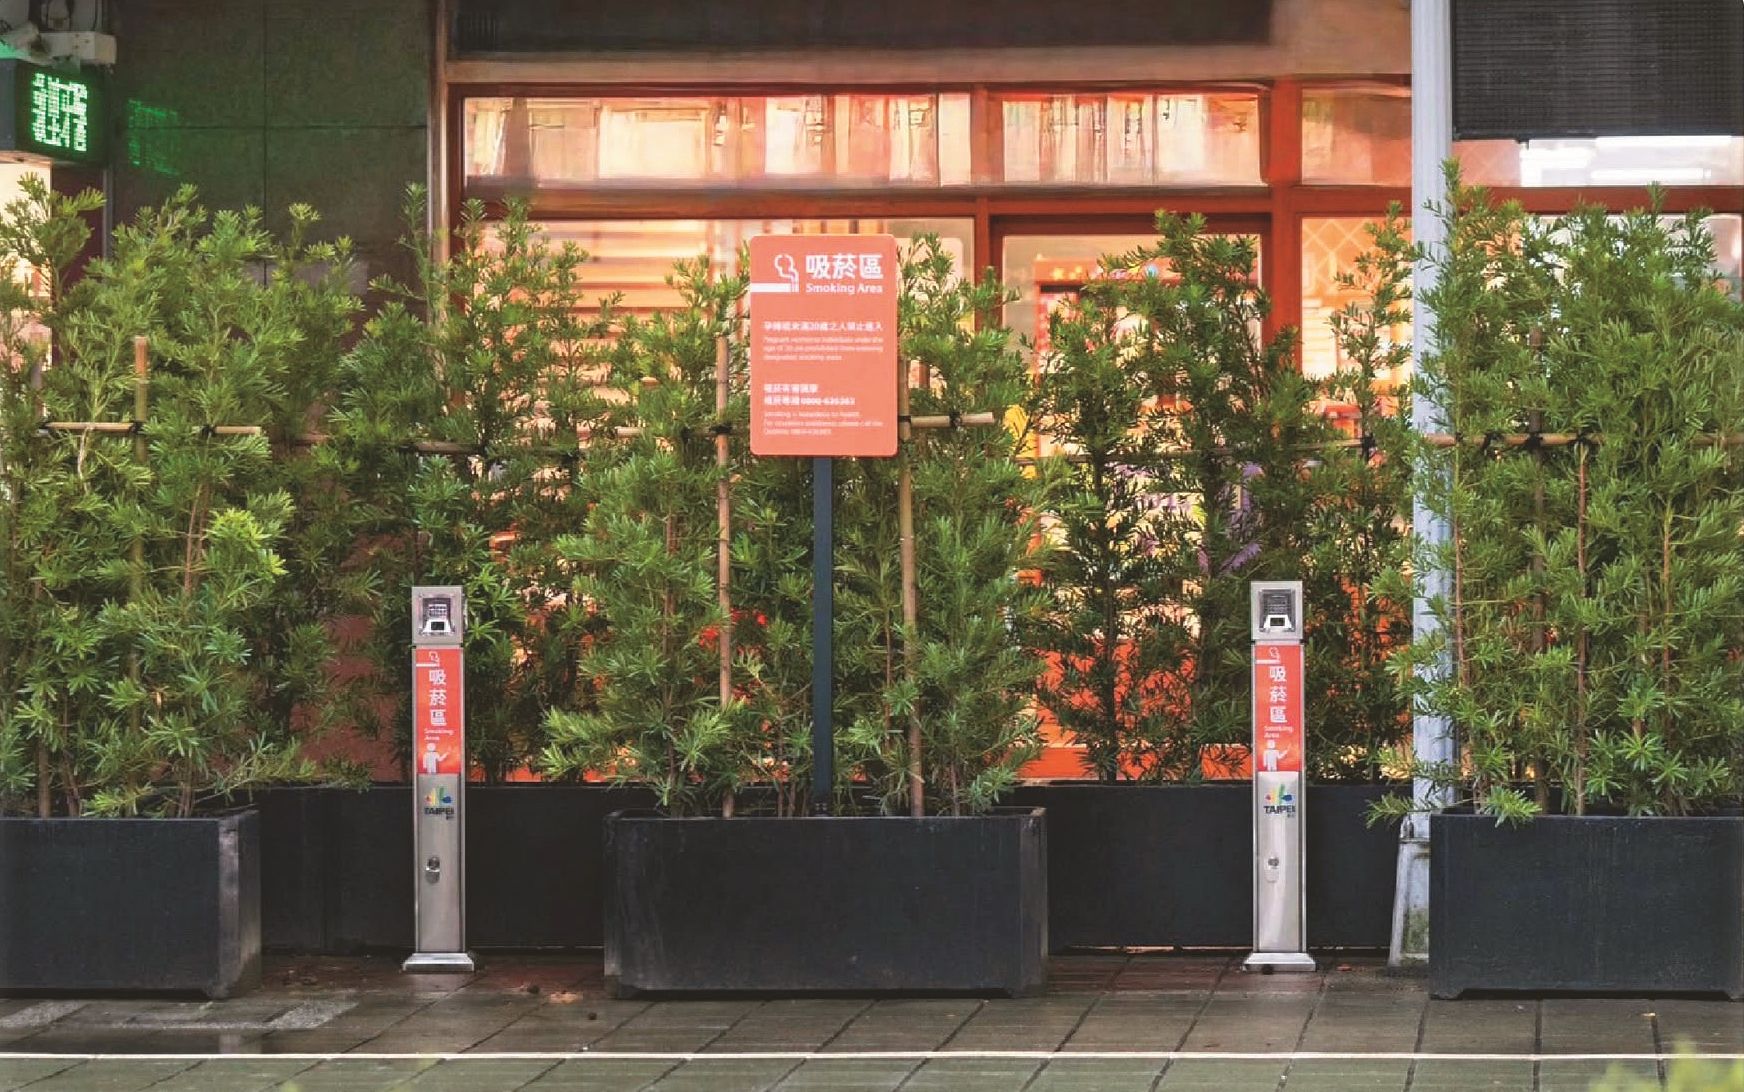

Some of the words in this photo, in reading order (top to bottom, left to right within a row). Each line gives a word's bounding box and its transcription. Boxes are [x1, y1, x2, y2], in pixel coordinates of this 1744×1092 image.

[805, 253, 884, 279] 吸菸區
[806, 283, 855, 295] Smoking
[858, 284, 883, 293] Area
[429, 669, 447, 726] 吸菸區
[1269, 666, 1287, 723] 吸菸區
[424, 807, 454, 815] TAIPEI
[1263, 805, 1296, 814] TAIPEI
